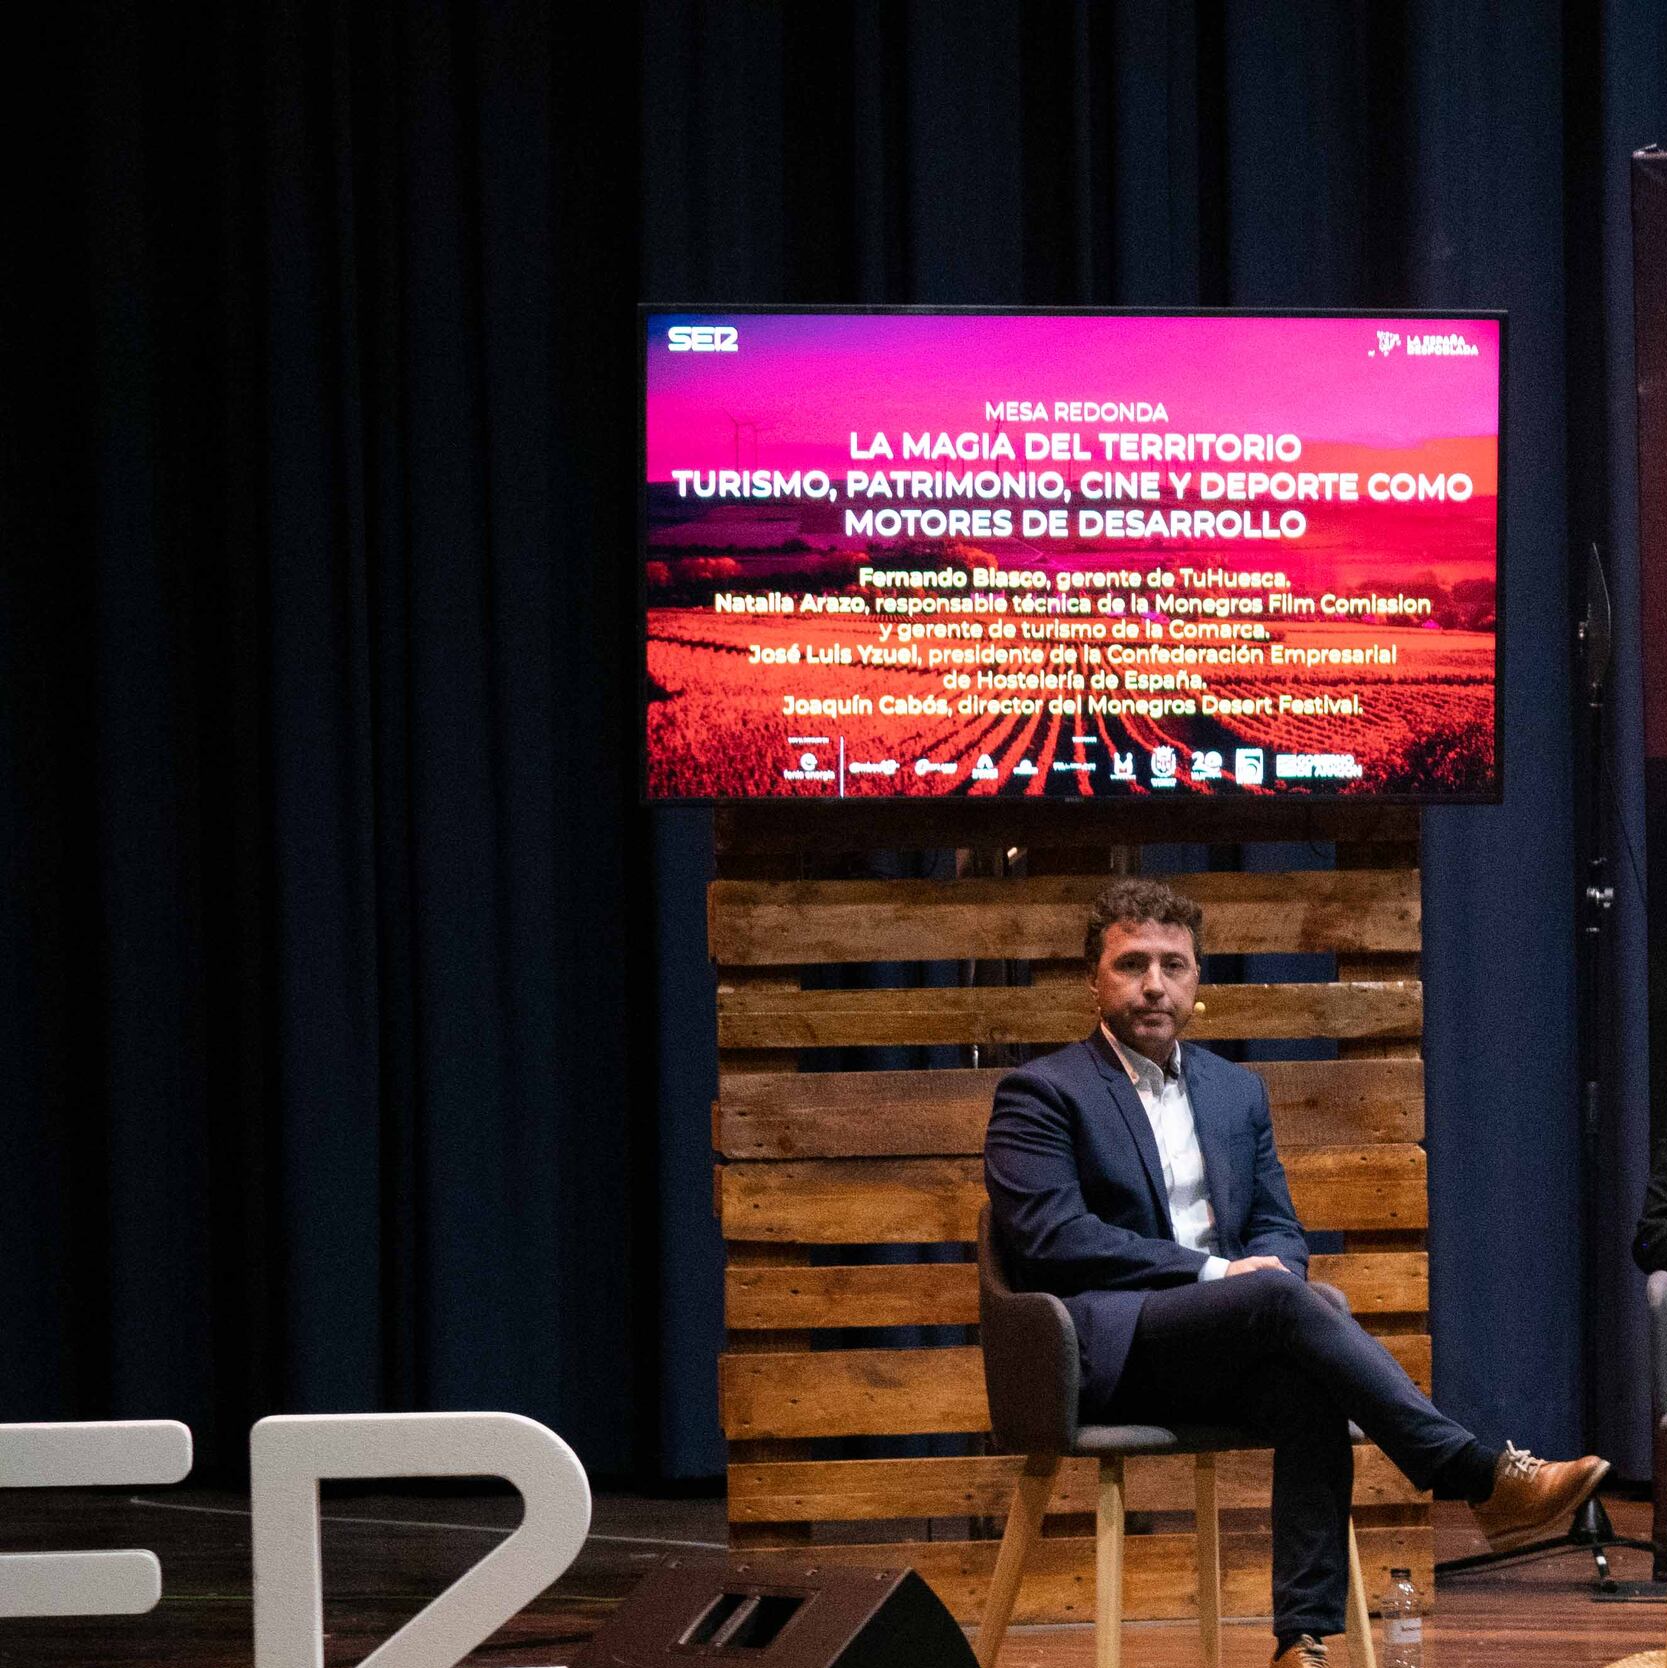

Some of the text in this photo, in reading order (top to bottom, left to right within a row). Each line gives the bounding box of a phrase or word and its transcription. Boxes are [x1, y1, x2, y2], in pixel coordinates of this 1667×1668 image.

[985, 401, 1169, 423] MESA REDONDA
[850, 431, 1302, 463] LA MAGIA DEL TERRITORIO
[671, 469, 1474, 504] TURISMO, PATRIMONIO, CINE Y DEPORTE COMO
[845, 508, 1307, 539] MOTORES DE DESARROLLO
[859, 566, 1292, 592] Fernando Blasco, gerente de TuHuesca.
[715, 591, 1432, 618] Natalia Arazo, responsable técnica de la Monegros Film Comission
[878, 618, 1270, 643] y gerente de turismo de la Comarca.
[748, 642, 1397, 668] José Luis Yzuel, presidente de la Confederación Empresarial
[942, 669, 1208, 694] de Hostelería de España.
[782, 693, 1364, 719] Joaquín Cabós, director del Monegros Desert Festival.
